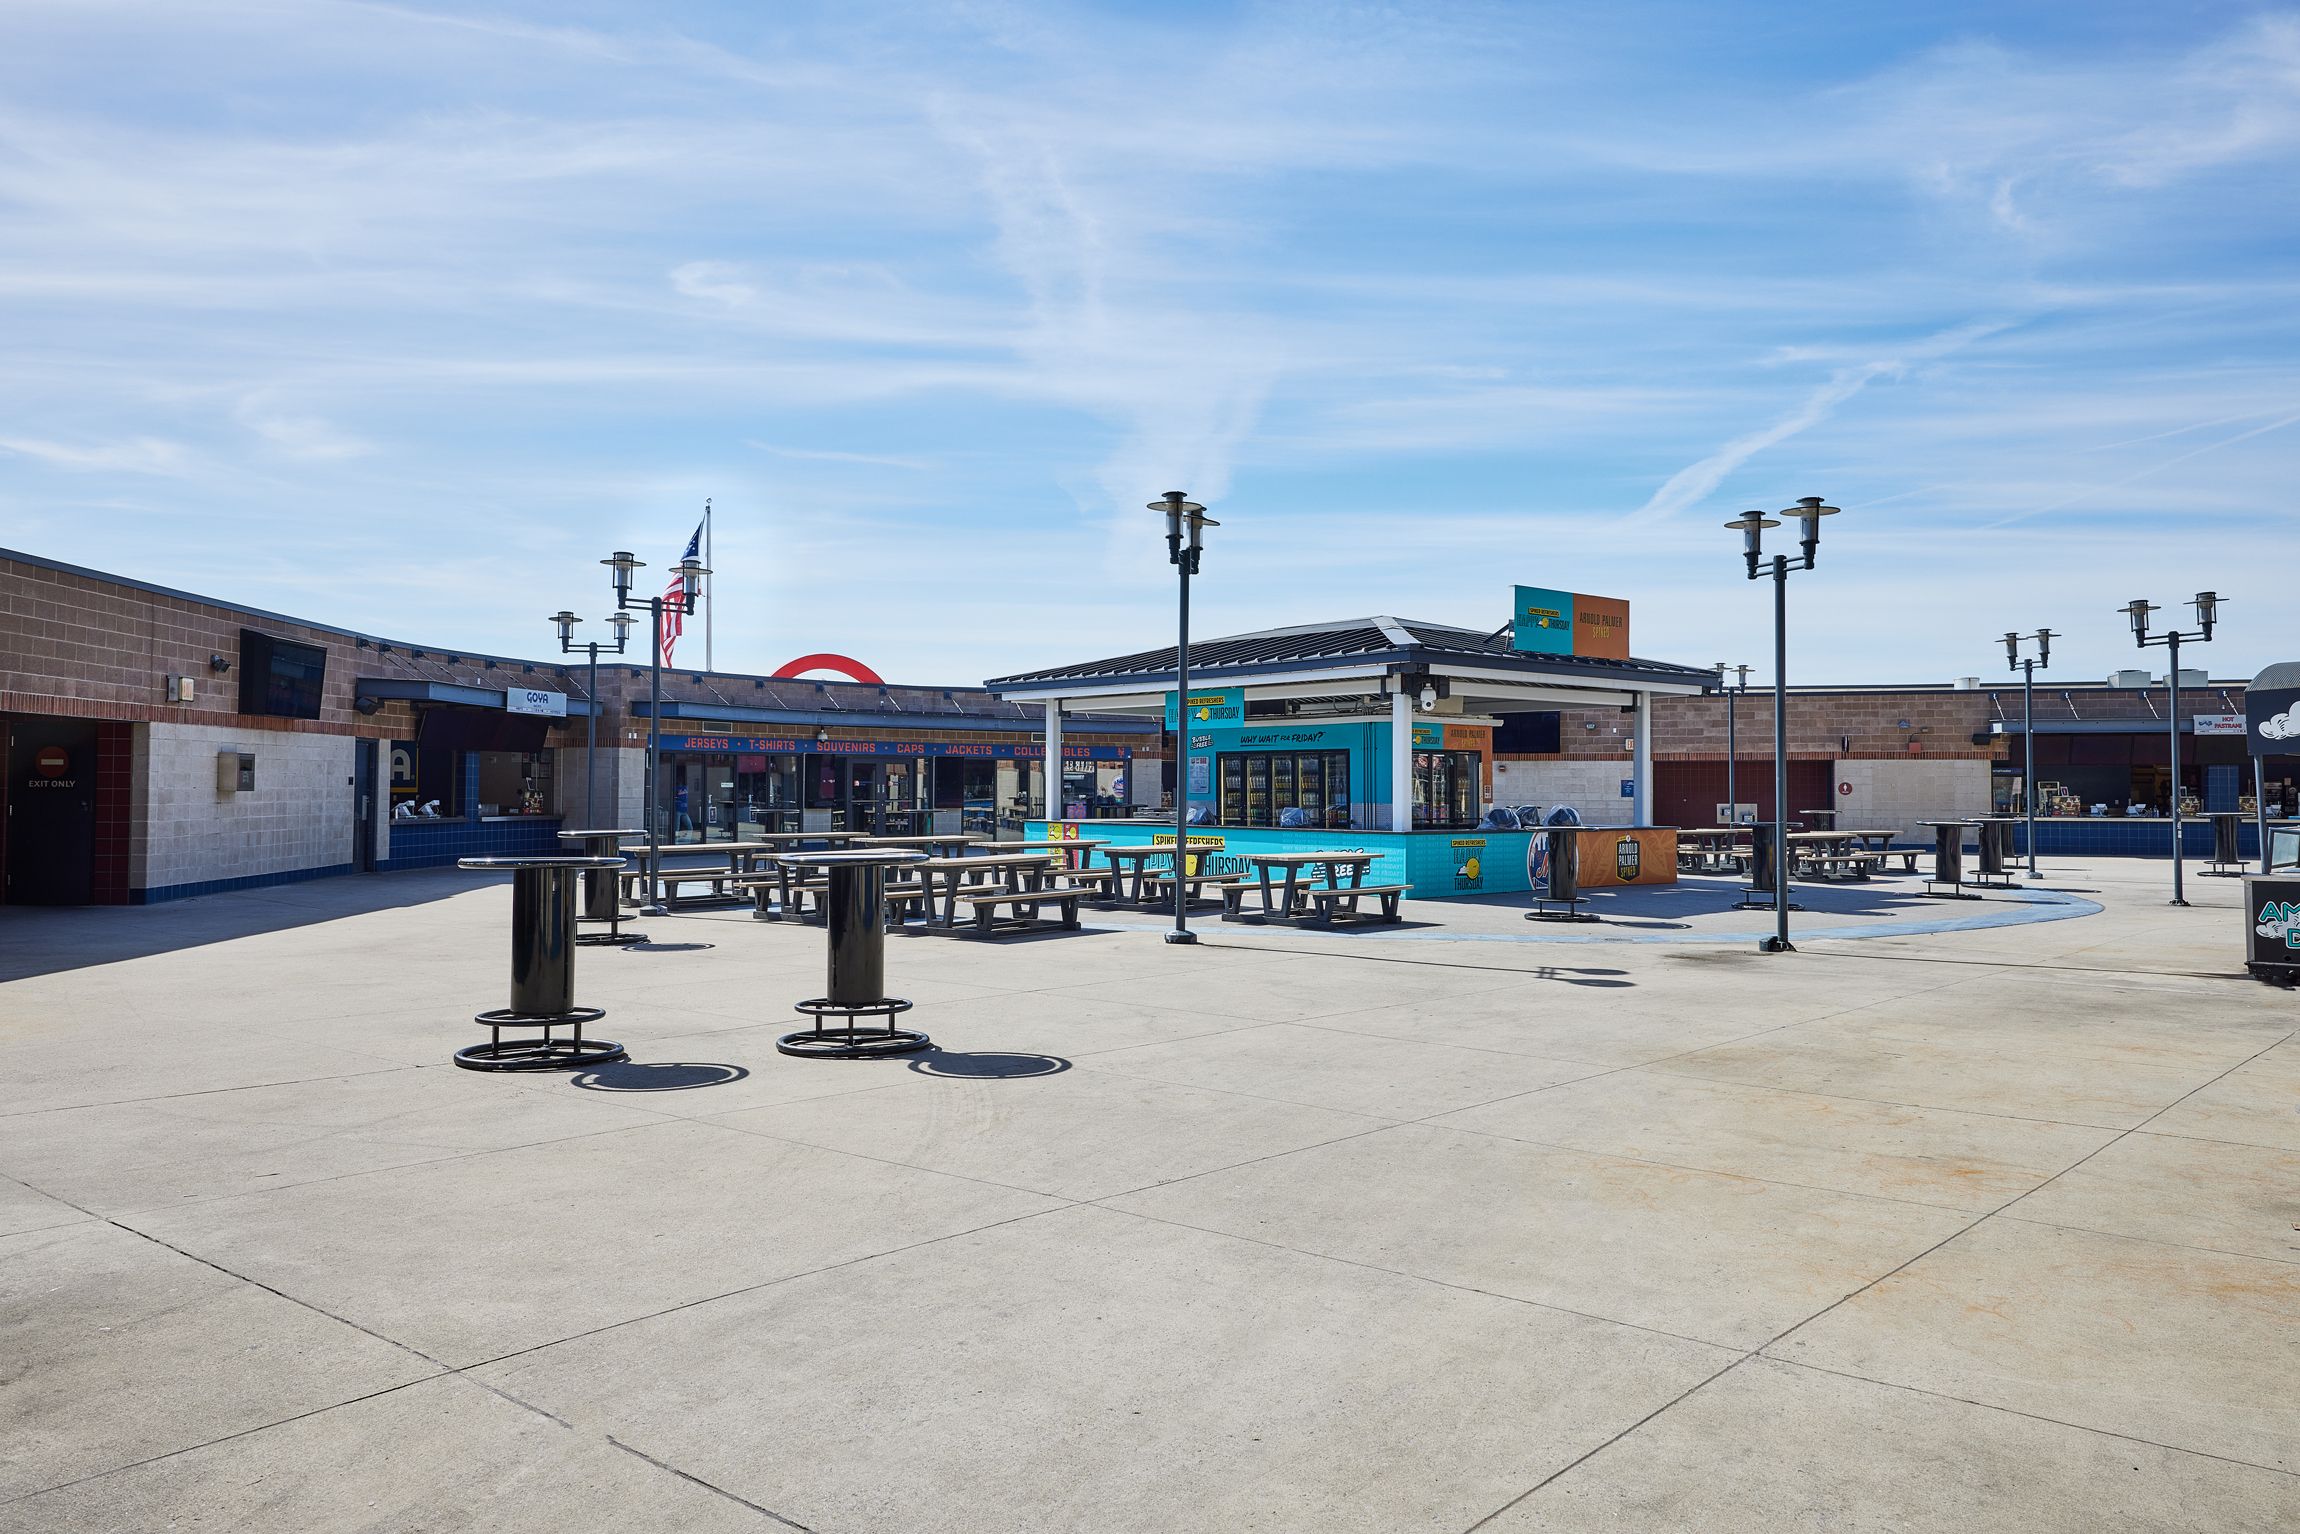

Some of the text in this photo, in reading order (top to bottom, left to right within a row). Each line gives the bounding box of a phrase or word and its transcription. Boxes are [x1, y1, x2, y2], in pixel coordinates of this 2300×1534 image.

[1548, 618, 1570, 631] THURSDAY
[1579, 612, 1623, 628] ARNOLD PALMER
[1592, 626, 1610, 639] SPIKED
[526, 692, 549, 704] GOYA
[1210, 706, 1240, 721] THURSDAY
[1240, 735, 1257, 744] WHY
[1258, 734, 1280, 744] WAIT
[1291, 731, 1327, 743] FRIDAY?
[684, 737, 729, 749] JERSEYS
[749, 739, 796, 751] T-SHIRTS
[816, 741, 876, 753] SOUVENIRS
[896, 743, 925, 754] CAPS
[945, 744, 993, 755] JACKETS
[28, 780, 76, 788] EXIT ONLY
[1618, 843, 1638, 855] ARNOLD
[1204, 856, 1252, 877] HURSDAY
[1618, 855, 1638, 866] PALMER
[1620, 866, 1636, 878] SPIKED
[1454, 876, 1484, 891] THURSDAY
